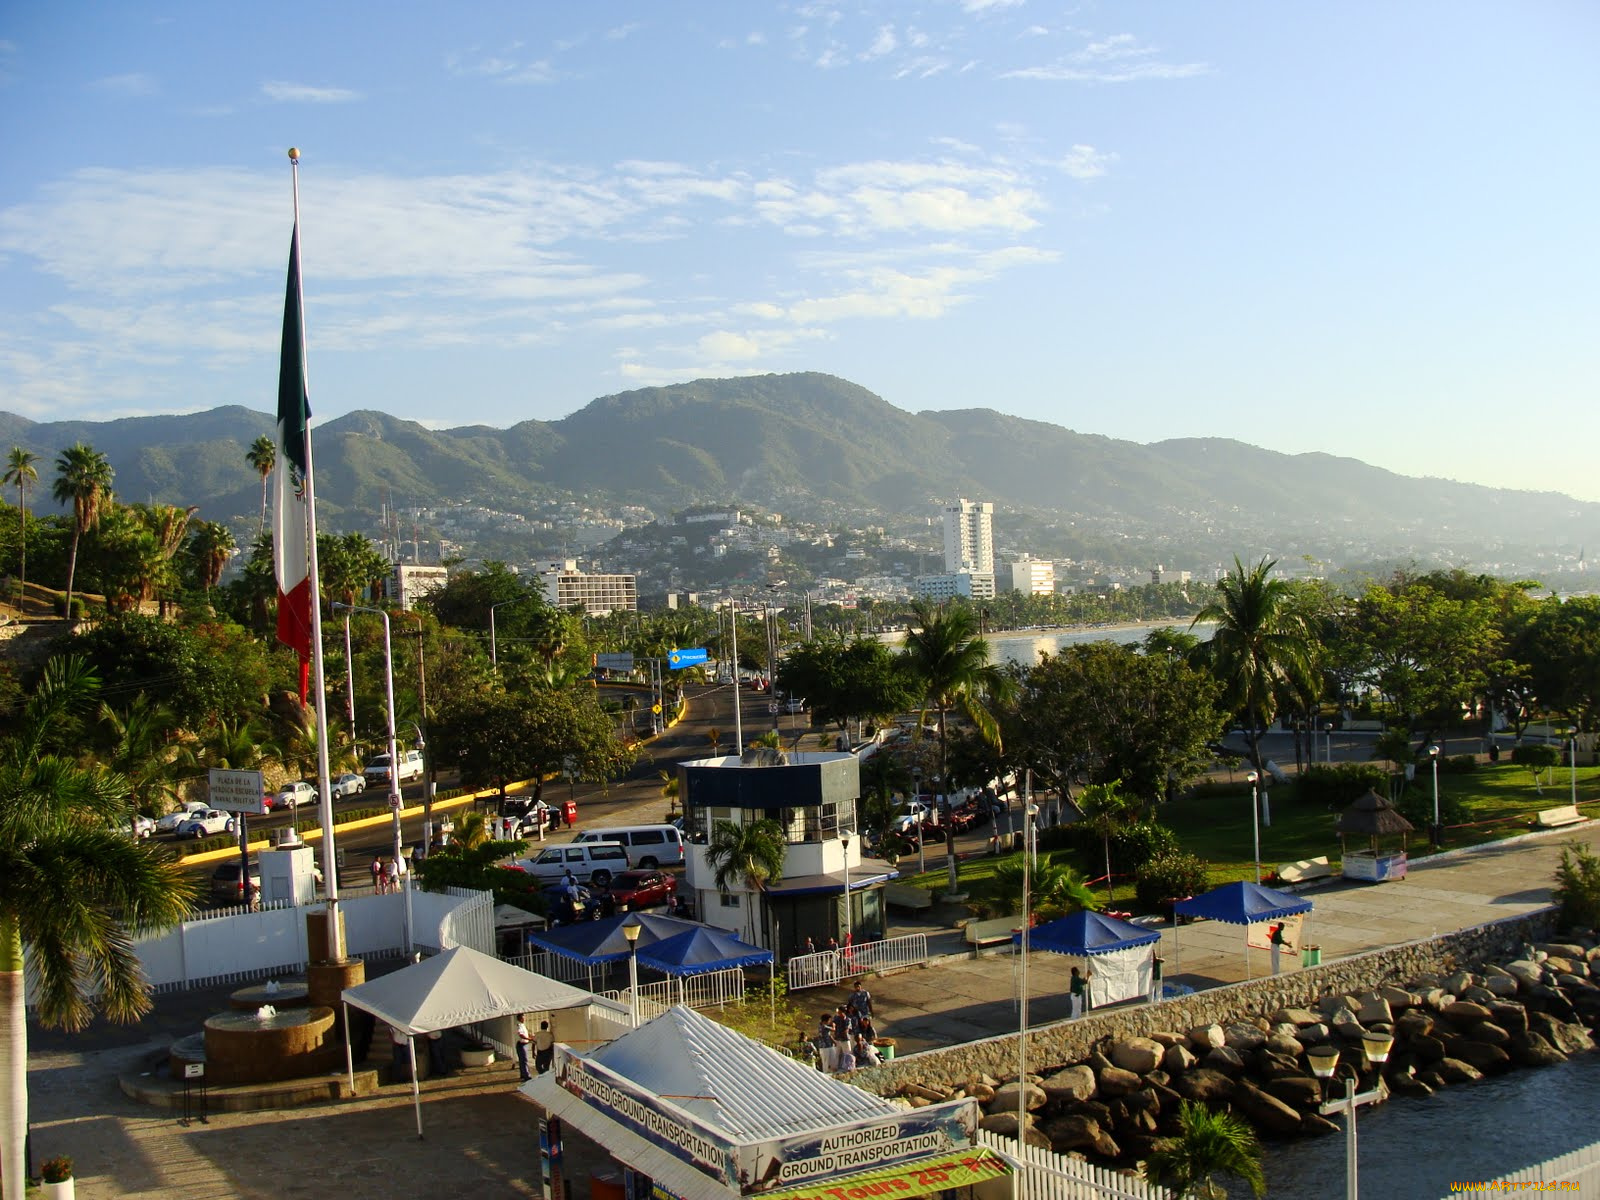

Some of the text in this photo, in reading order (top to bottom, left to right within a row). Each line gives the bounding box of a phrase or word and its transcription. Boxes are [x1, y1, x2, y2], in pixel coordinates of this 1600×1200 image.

[218, 776, 251, 786] PLAZA DE LA
[235, 788, 259, 796] ESCUELA
[567, 1065, 725, 1168] AUTHORIZED GROUND TRANSPORTATION
[822, 1125, 898, 1152] AUTHORIZED
[782, 1156, 834, 1178] GROUND
[837, 1134, 938, 1167] TRANSPORTATION
[824, 1178, 911, 1200] Tours
